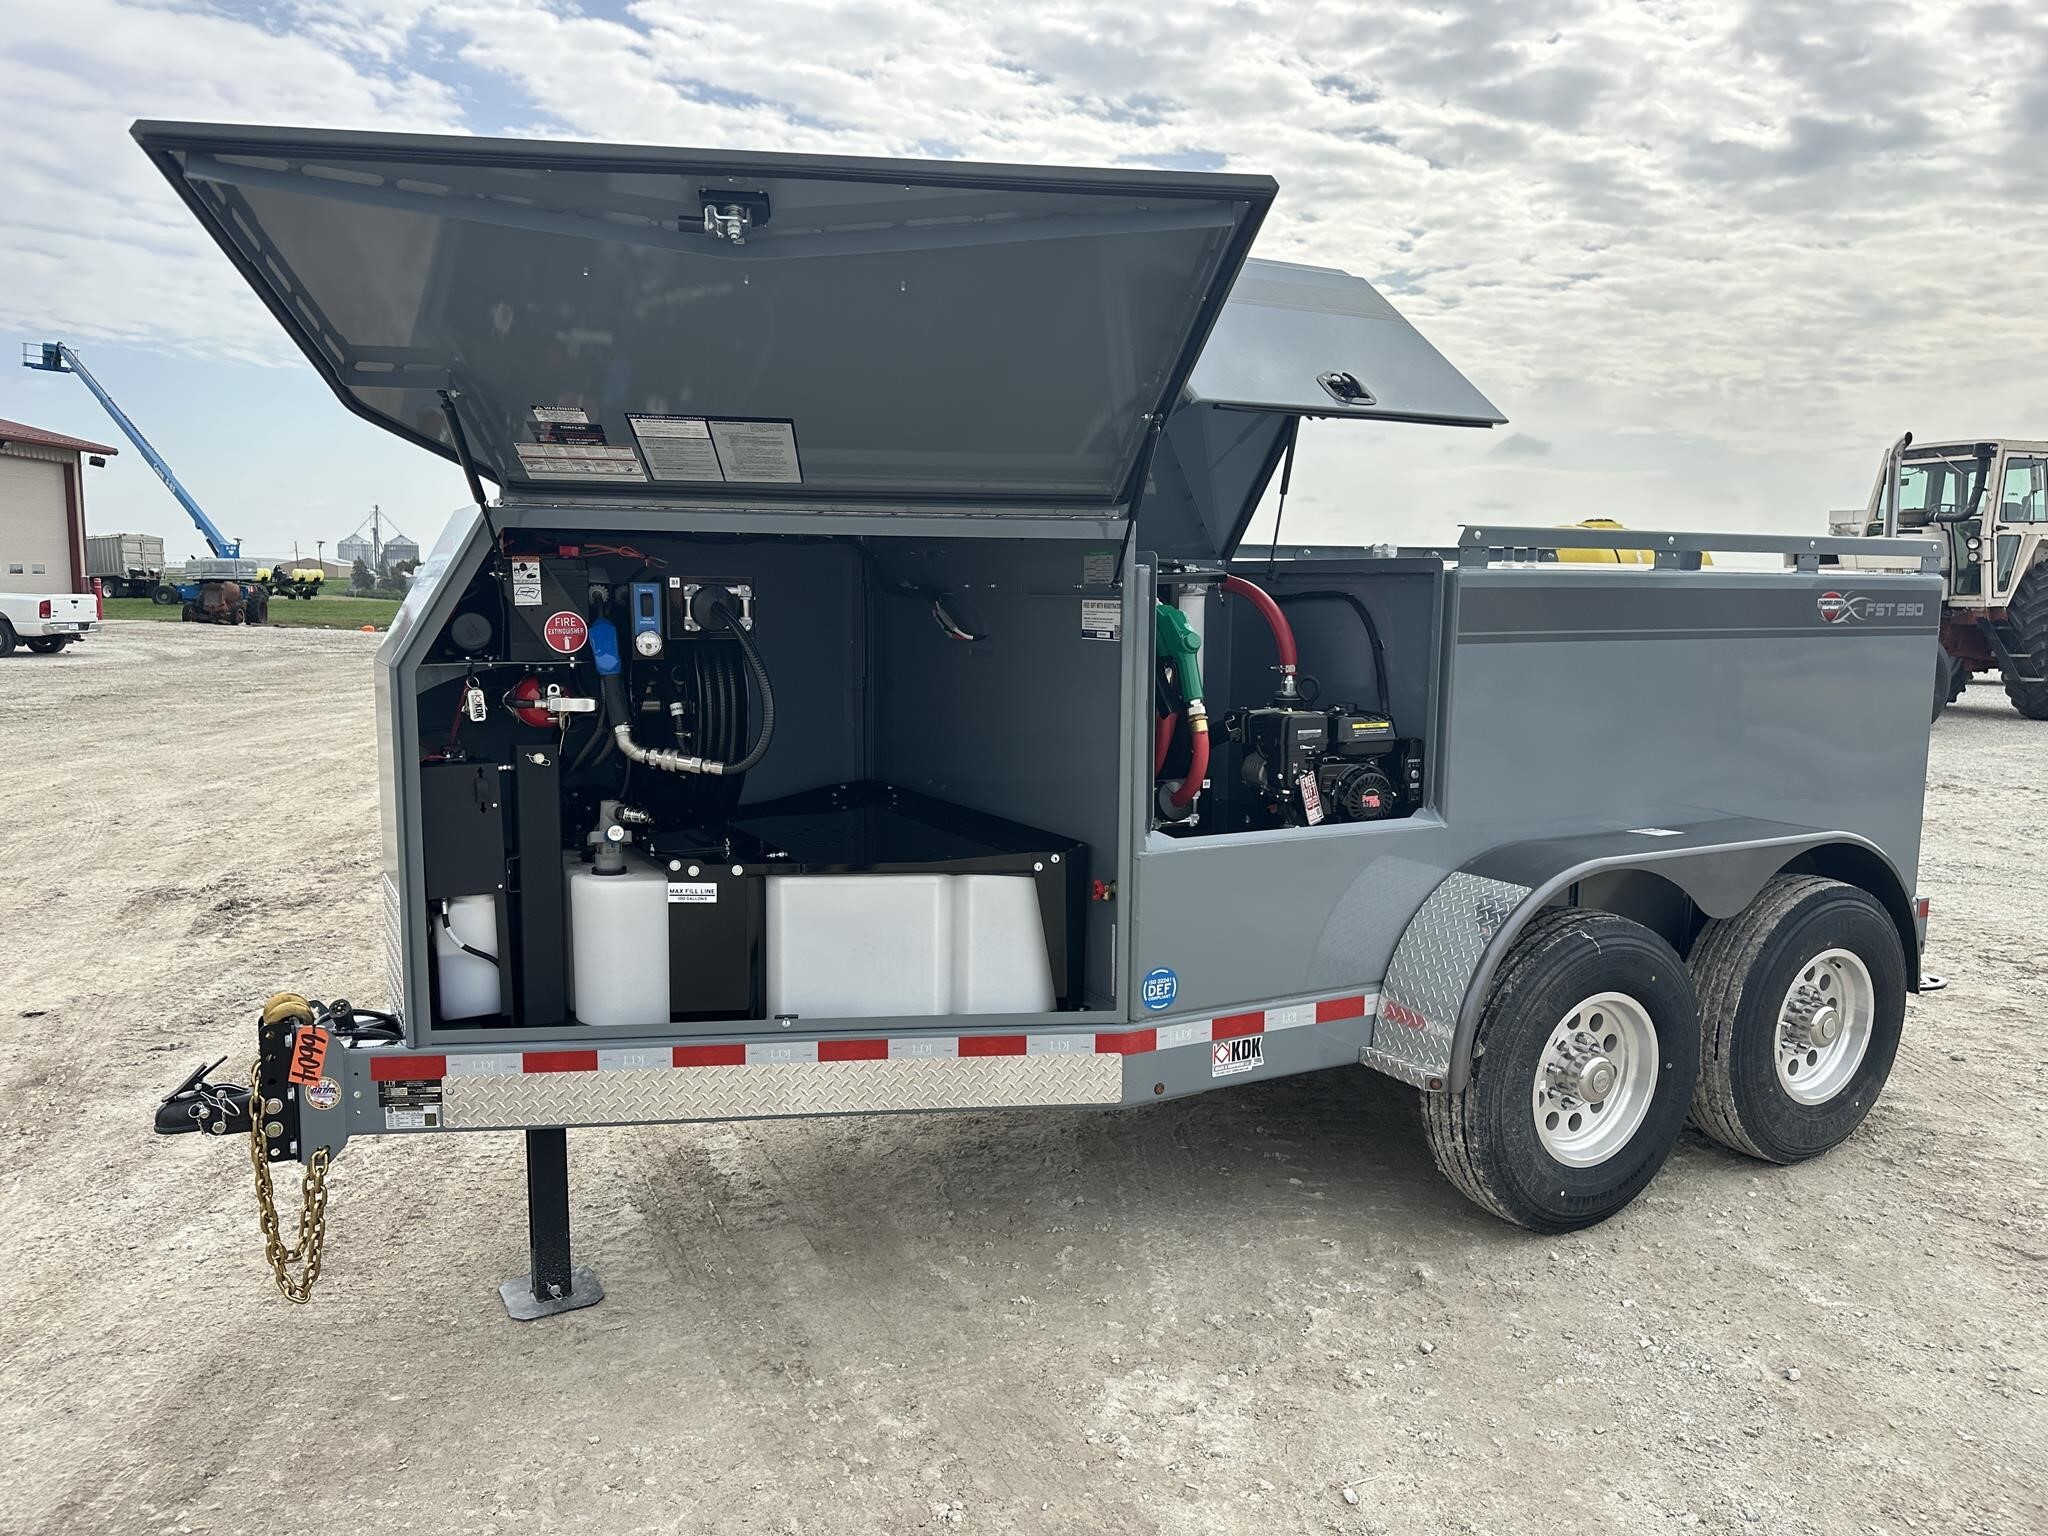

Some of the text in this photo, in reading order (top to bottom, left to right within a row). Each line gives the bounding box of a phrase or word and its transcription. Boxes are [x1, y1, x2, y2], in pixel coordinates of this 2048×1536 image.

[1865, 603, 1924, 617] FST 990
[555, 617, 576, 627] FIRE
[475, 703, 485, 719] KDK
[1148, 983, 1171, 997] DEF
[1231, 1037, 1261, 1062] KDK
[292, 1033, 326, 1082] 6604
